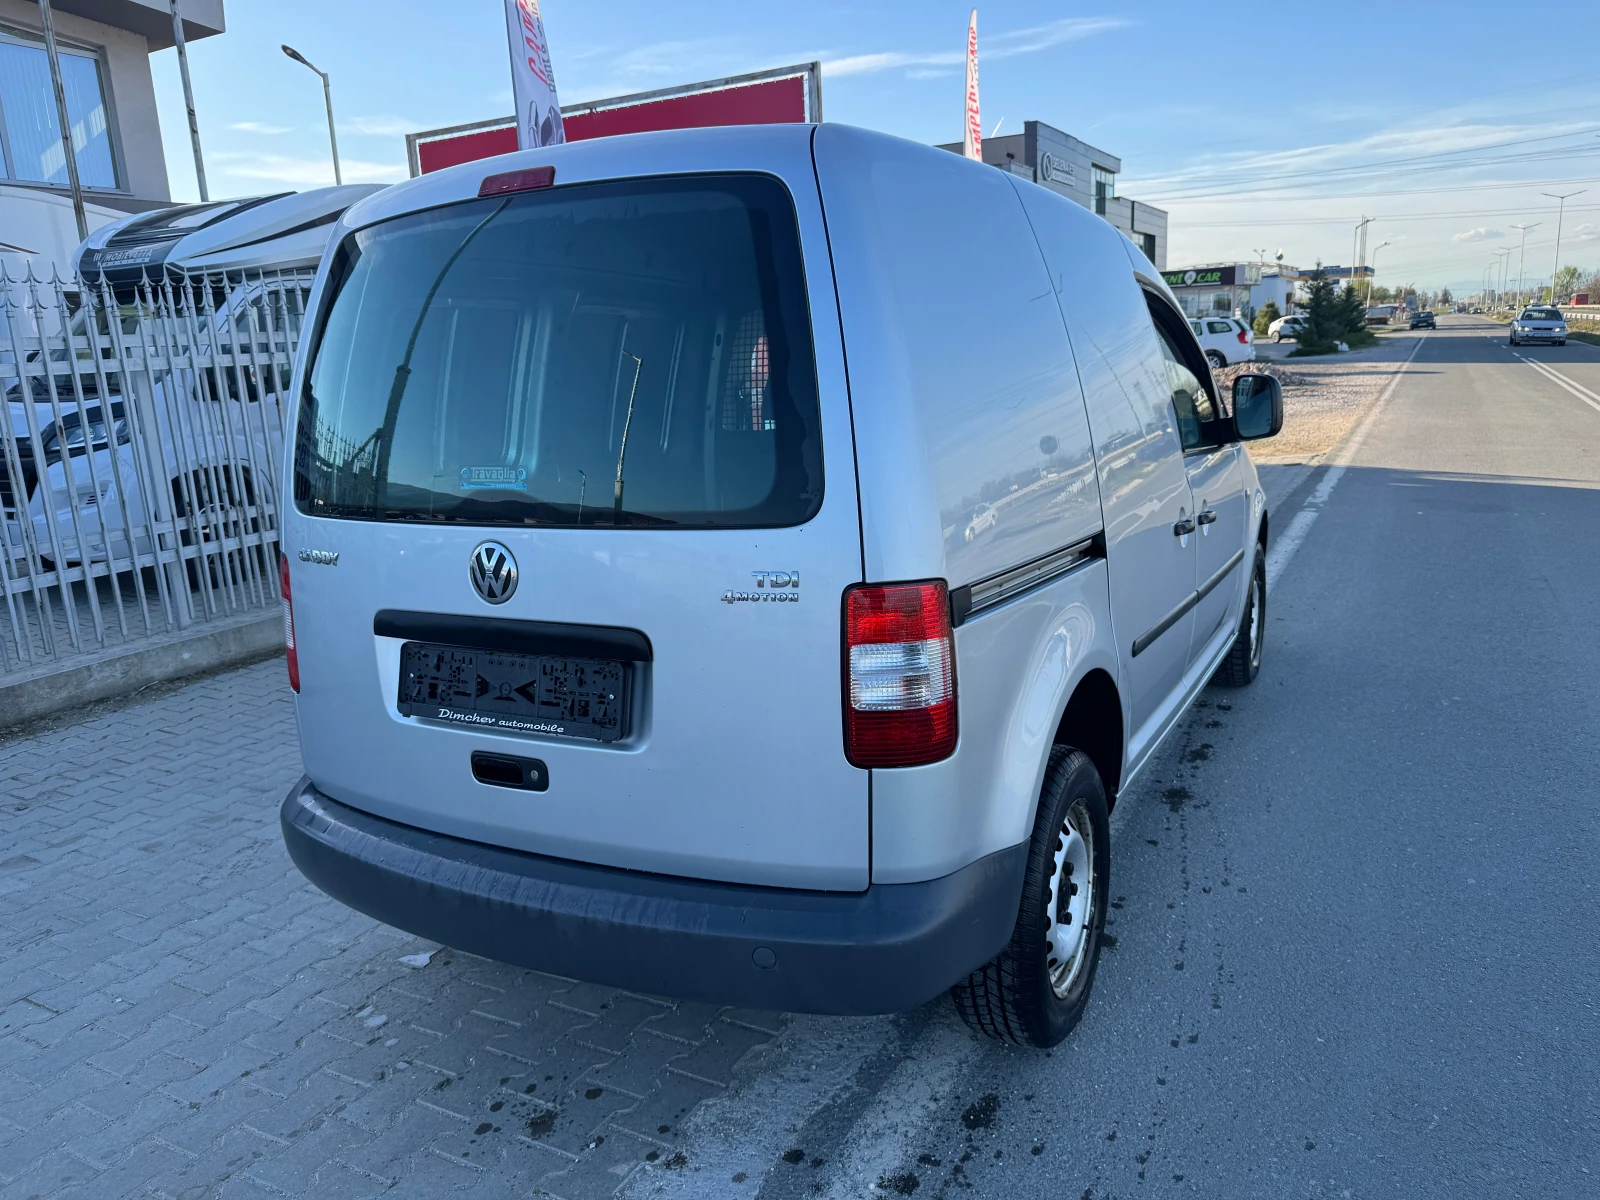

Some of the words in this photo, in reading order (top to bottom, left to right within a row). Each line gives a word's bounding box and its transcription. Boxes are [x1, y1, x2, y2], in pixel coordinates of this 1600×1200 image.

[1164, 273, 1184, 284] ENT
[1197, 272, 1221, 283] CAR
[470, 466, 516, 483] Travaglia
[298, 547, 340, 567] CADDY
[751, 570, 800, 589] TDI
[720, 589, 800, 605] 4MOTION
[438, 708, 496, 724] Dimchev
[498, 719, 564, 734] automobile
